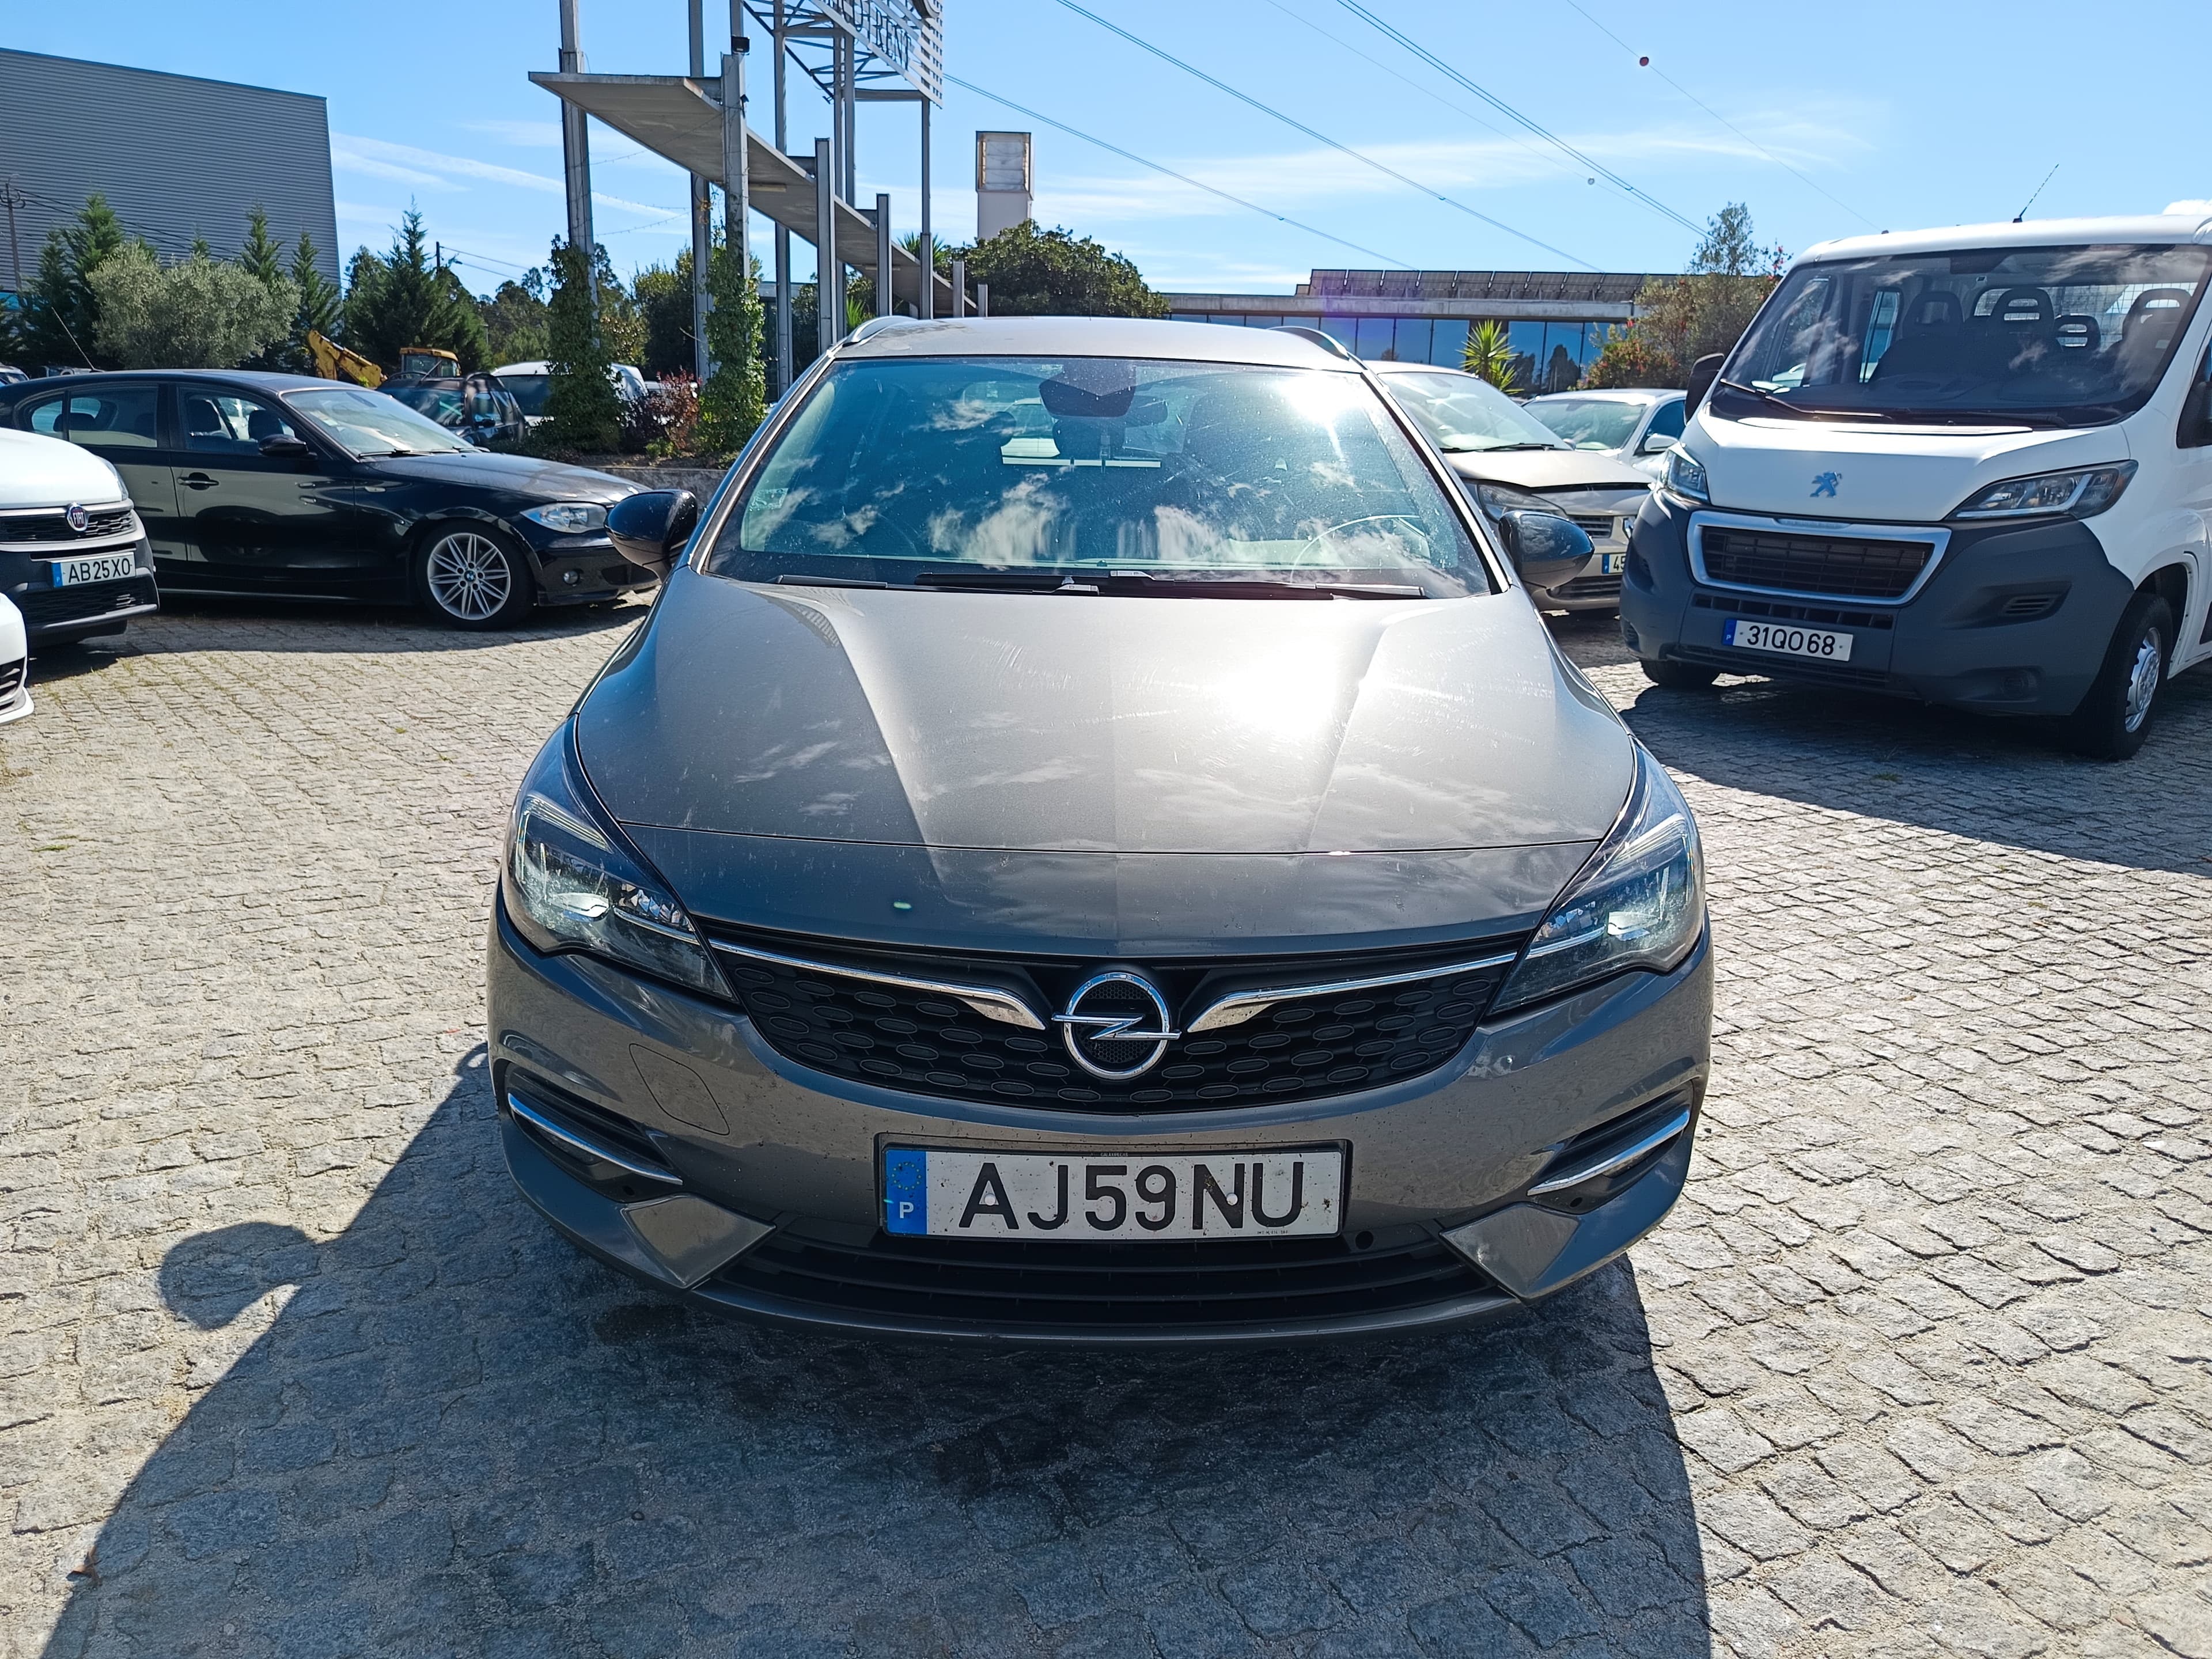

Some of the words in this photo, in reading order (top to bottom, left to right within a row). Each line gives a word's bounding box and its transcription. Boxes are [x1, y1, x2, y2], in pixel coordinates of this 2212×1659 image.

[73, 512, 85, 525] FIAT
[68, 558, 131, 584] AB25XO
[1747, 625, 1836, 656] 31QO68
[899, 1202, 914, 1219] P
[958, 1161, 1305, 1232] AJ59NU
